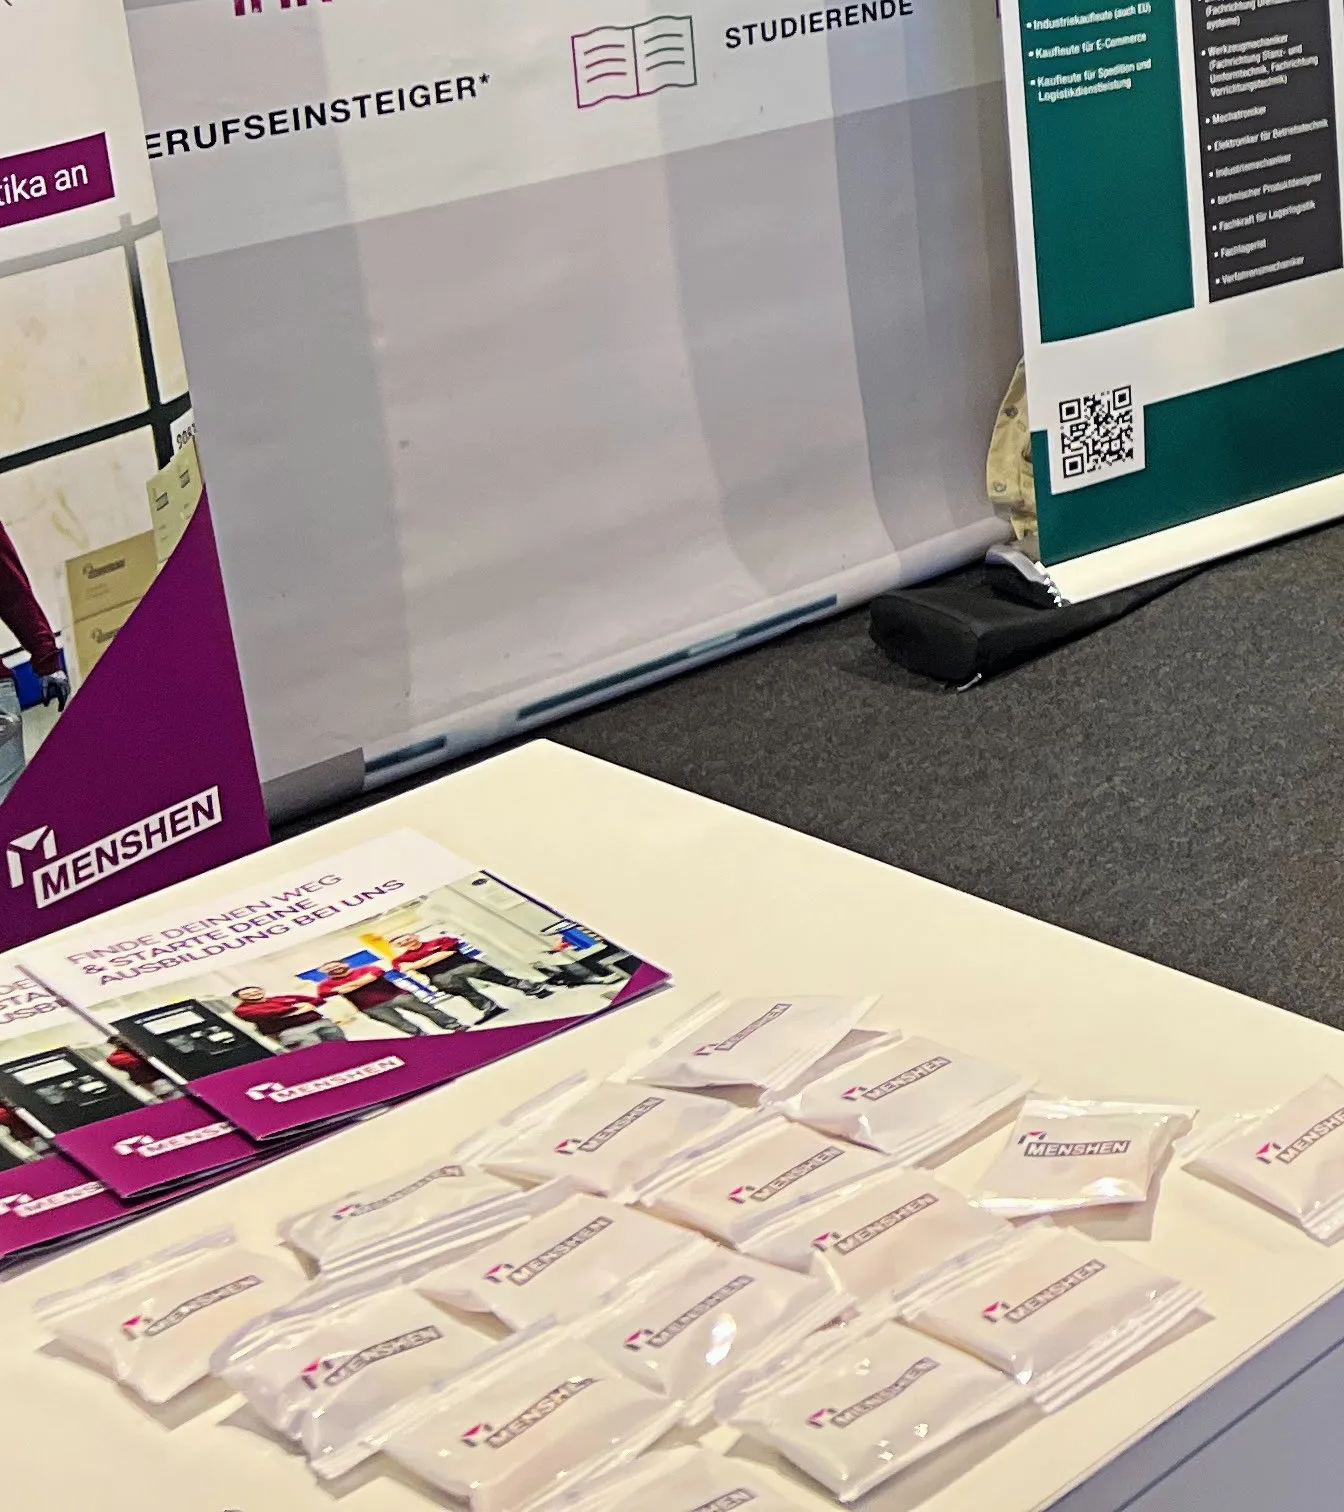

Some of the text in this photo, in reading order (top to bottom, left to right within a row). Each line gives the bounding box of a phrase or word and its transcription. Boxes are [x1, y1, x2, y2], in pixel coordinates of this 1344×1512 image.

[54, 163, 89, 192] an
[40, 791, 218, 904] MENSHEN
[66, 874, 342, 966] FINDE DEINEN WEG
[101, 879, 405, 986] AUSBILDUNG BEI UNS
[110, 929, 225, 968] STARTE
[228, 898, 318, 934] DEINE
[273, 1056, 404, 1102] MENSHEN
[866, 1056, 952, 1101] MENSHEN
[577, 1096, 665, 1152] MENSHEN
[1024, 1139, 1131, 1158] MENSHEN
[750, 1145, 846, 1202] MENSHEN
[508, 1216, 613, 1286] MENSHEN
[834, 1193, 939, 1254] MENSHEN
[1005, 1259, 1107, 1322] MENSHEN
